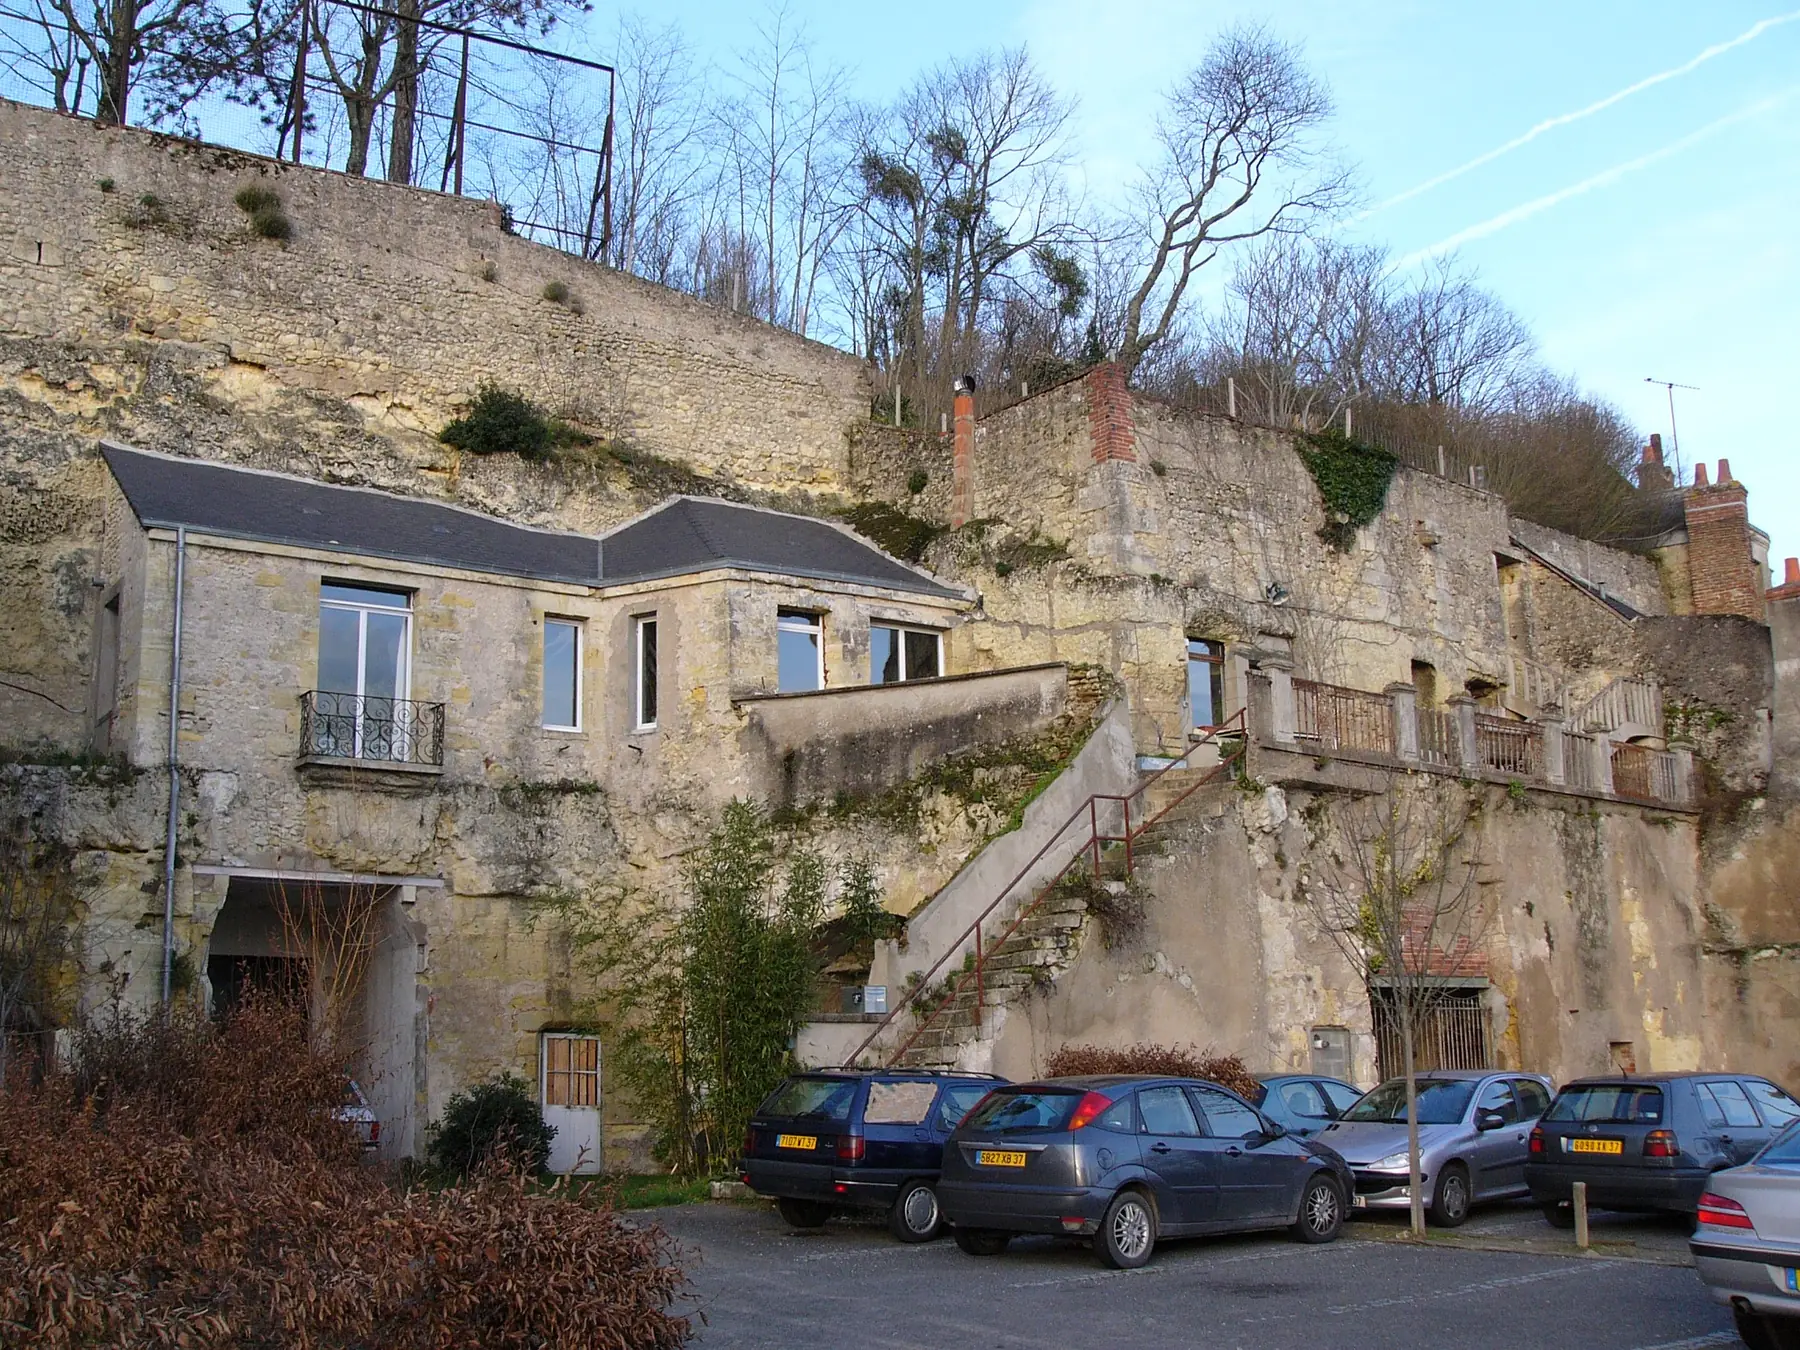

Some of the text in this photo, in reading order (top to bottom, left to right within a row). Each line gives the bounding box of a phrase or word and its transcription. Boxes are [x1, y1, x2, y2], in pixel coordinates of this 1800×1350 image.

[806, 1138, 816, 1148] 37
[1608, 1142, 1620, 1152] 37
[980, 1152, 1024, 1165] 5827 XB 37
